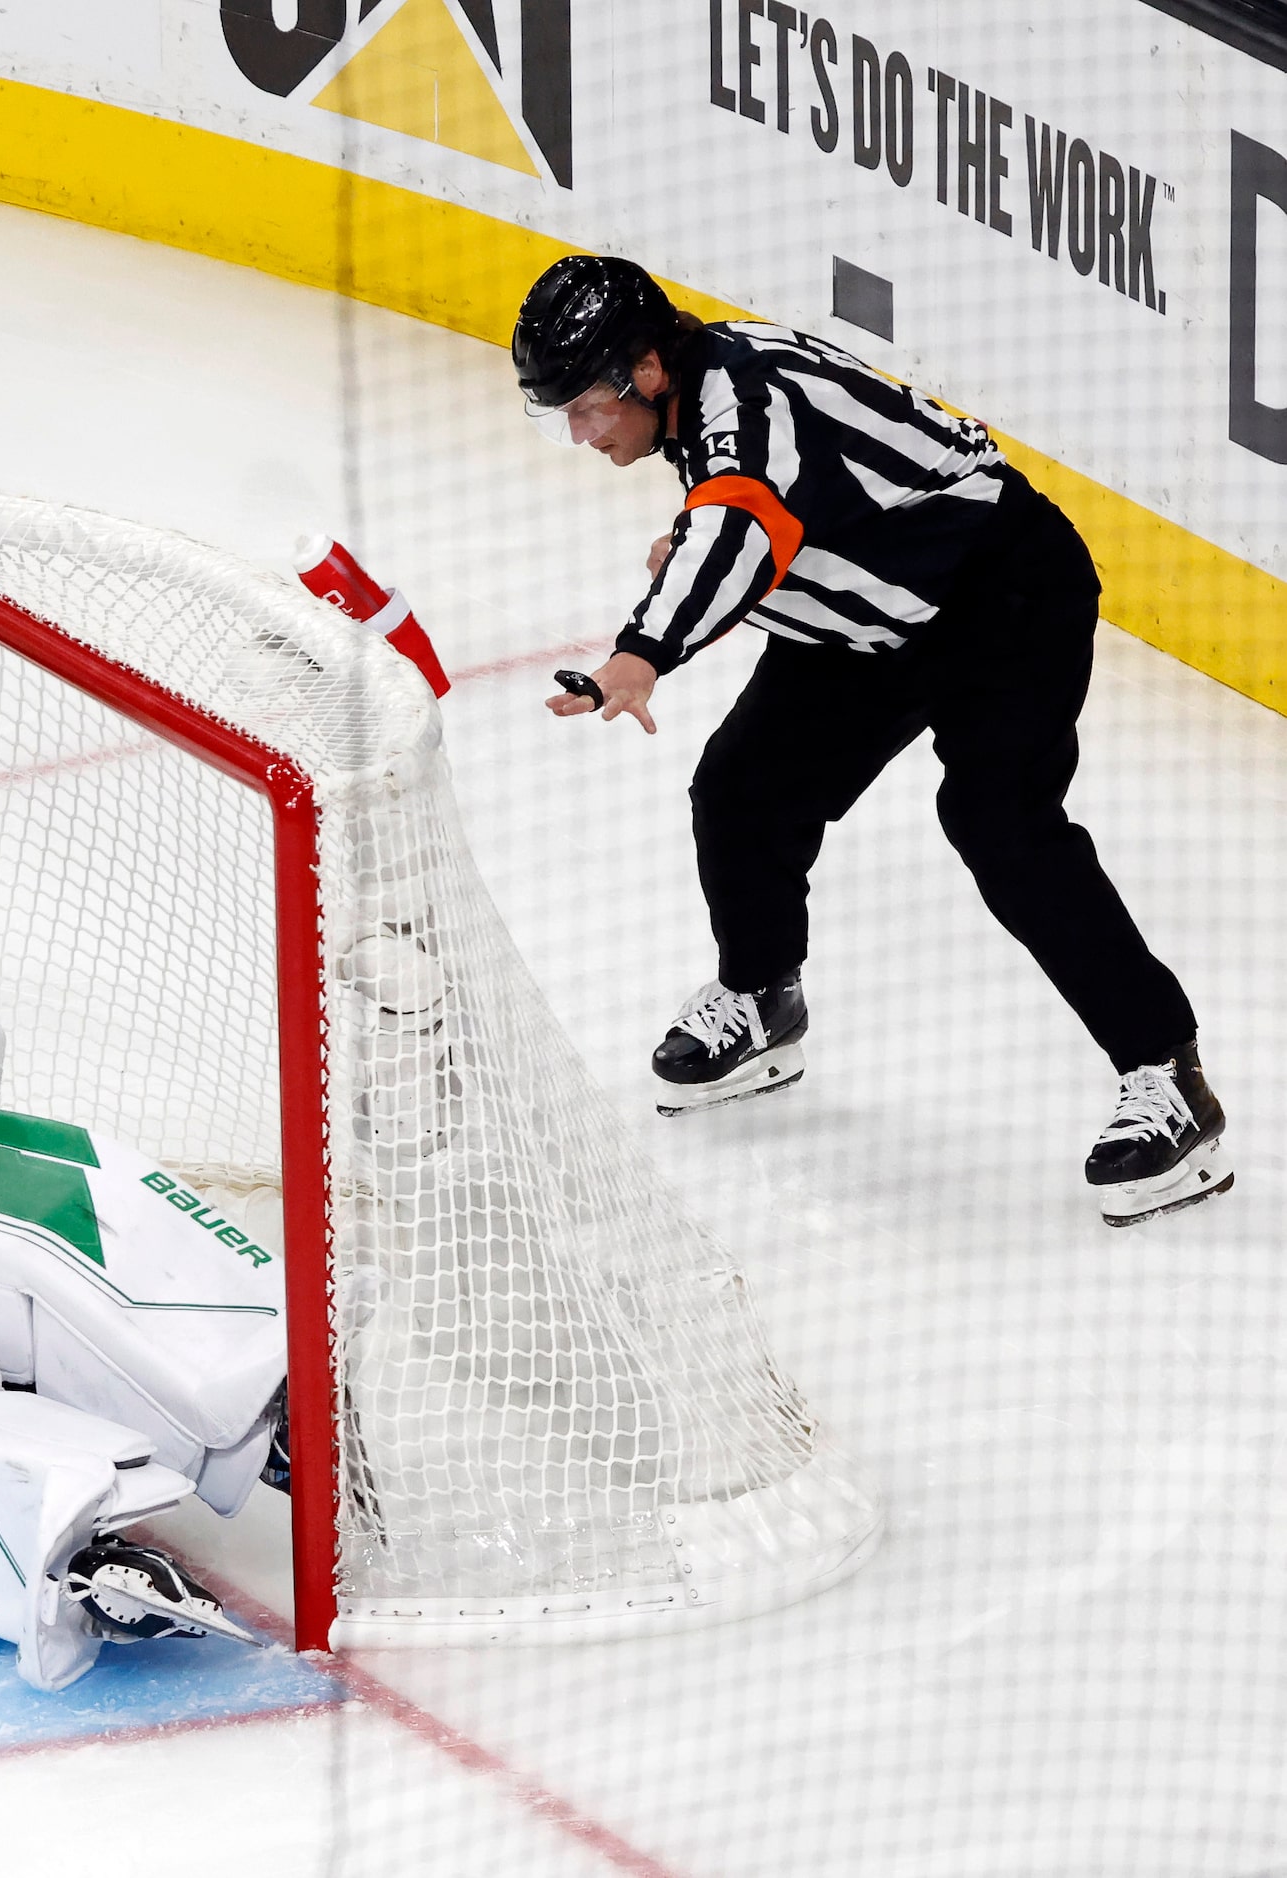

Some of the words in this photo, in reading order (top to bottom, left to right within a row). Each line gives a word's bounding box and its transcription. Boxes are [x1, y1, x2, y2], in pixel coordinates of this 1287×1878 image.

[710, 0, 839, 153] LET'S
[852, 33, 913, 188] DO
[705, 433, 738, 456] 14
[139, 1170, 273, 1269] BAUER
